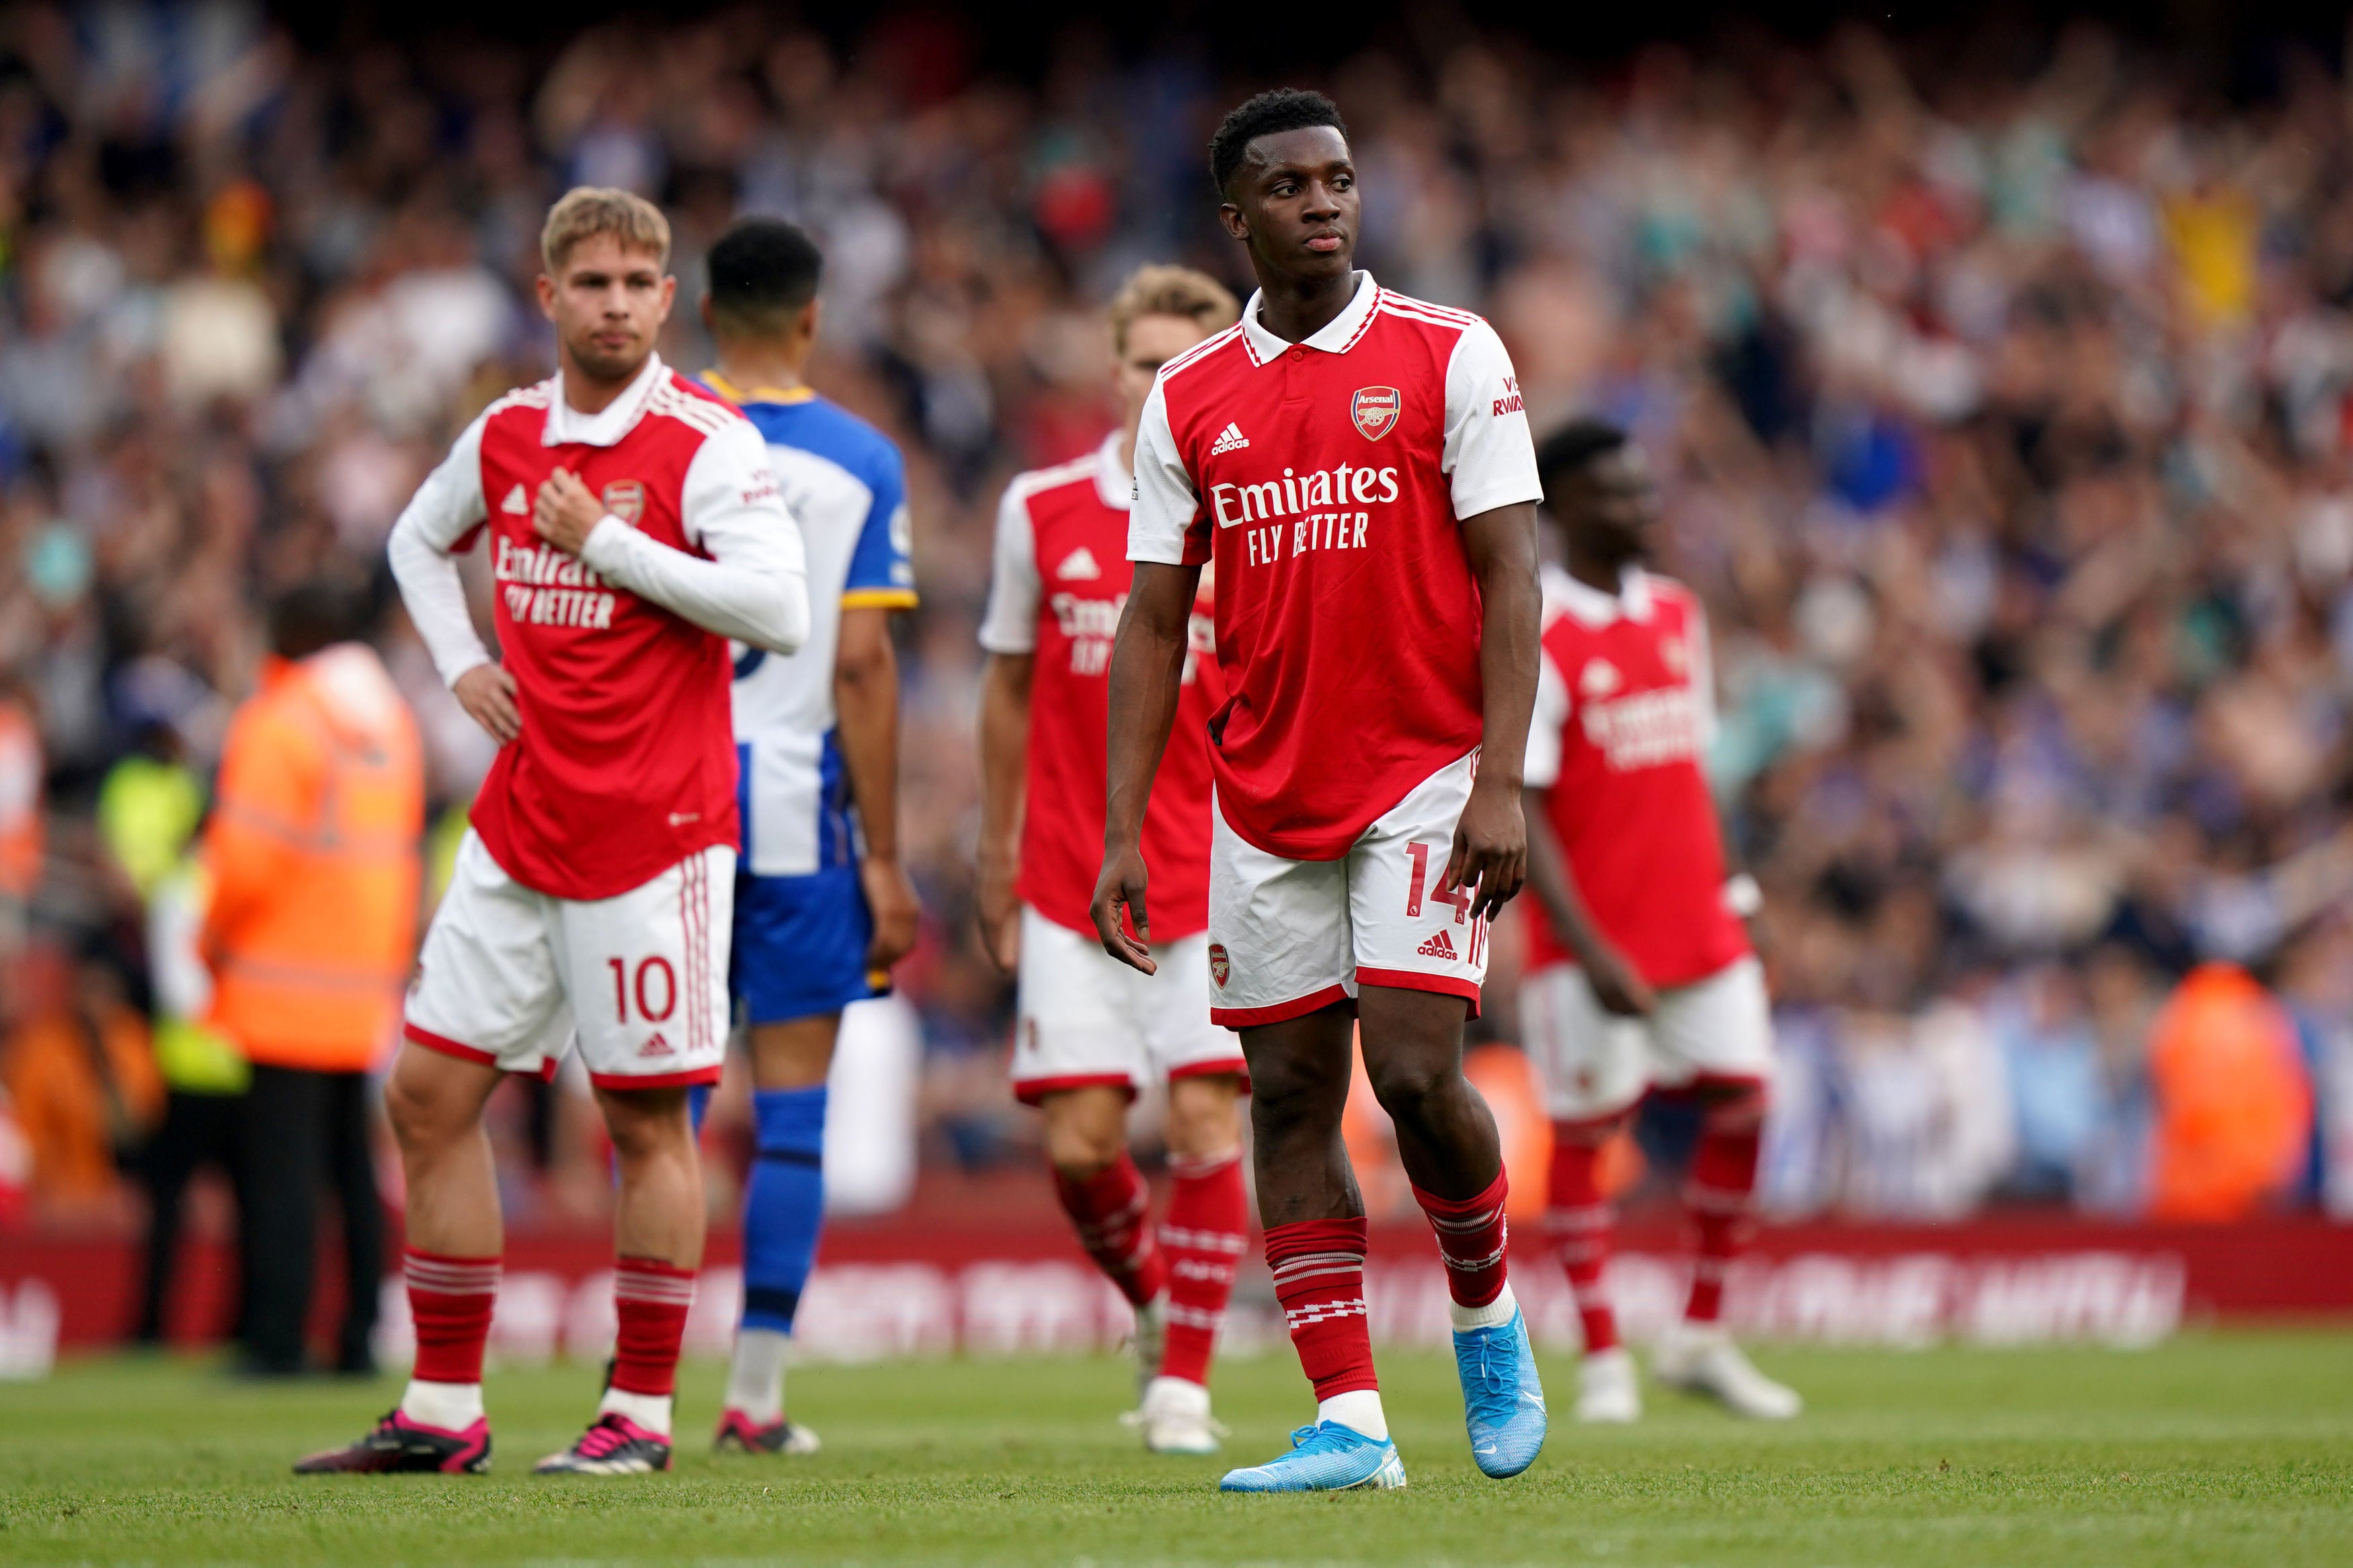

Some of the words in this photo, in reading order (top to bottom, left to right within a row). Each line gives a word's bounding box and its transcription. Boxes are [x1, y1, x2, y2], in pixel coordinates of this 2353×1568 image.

[1359, 395, 1394, 403] Arsenal
[1211, 438, 1250, 456] adidas
[1209, 461, 1399, 529] Emirates
[1247, 524, 1283, 567] FLY
[1292, 512, 1369, 558] BETTER
[1405, 841, 1471, 925] 14
[1417, 946, 1458, 960] adidas
[607, 956, 676, 1024] 10
